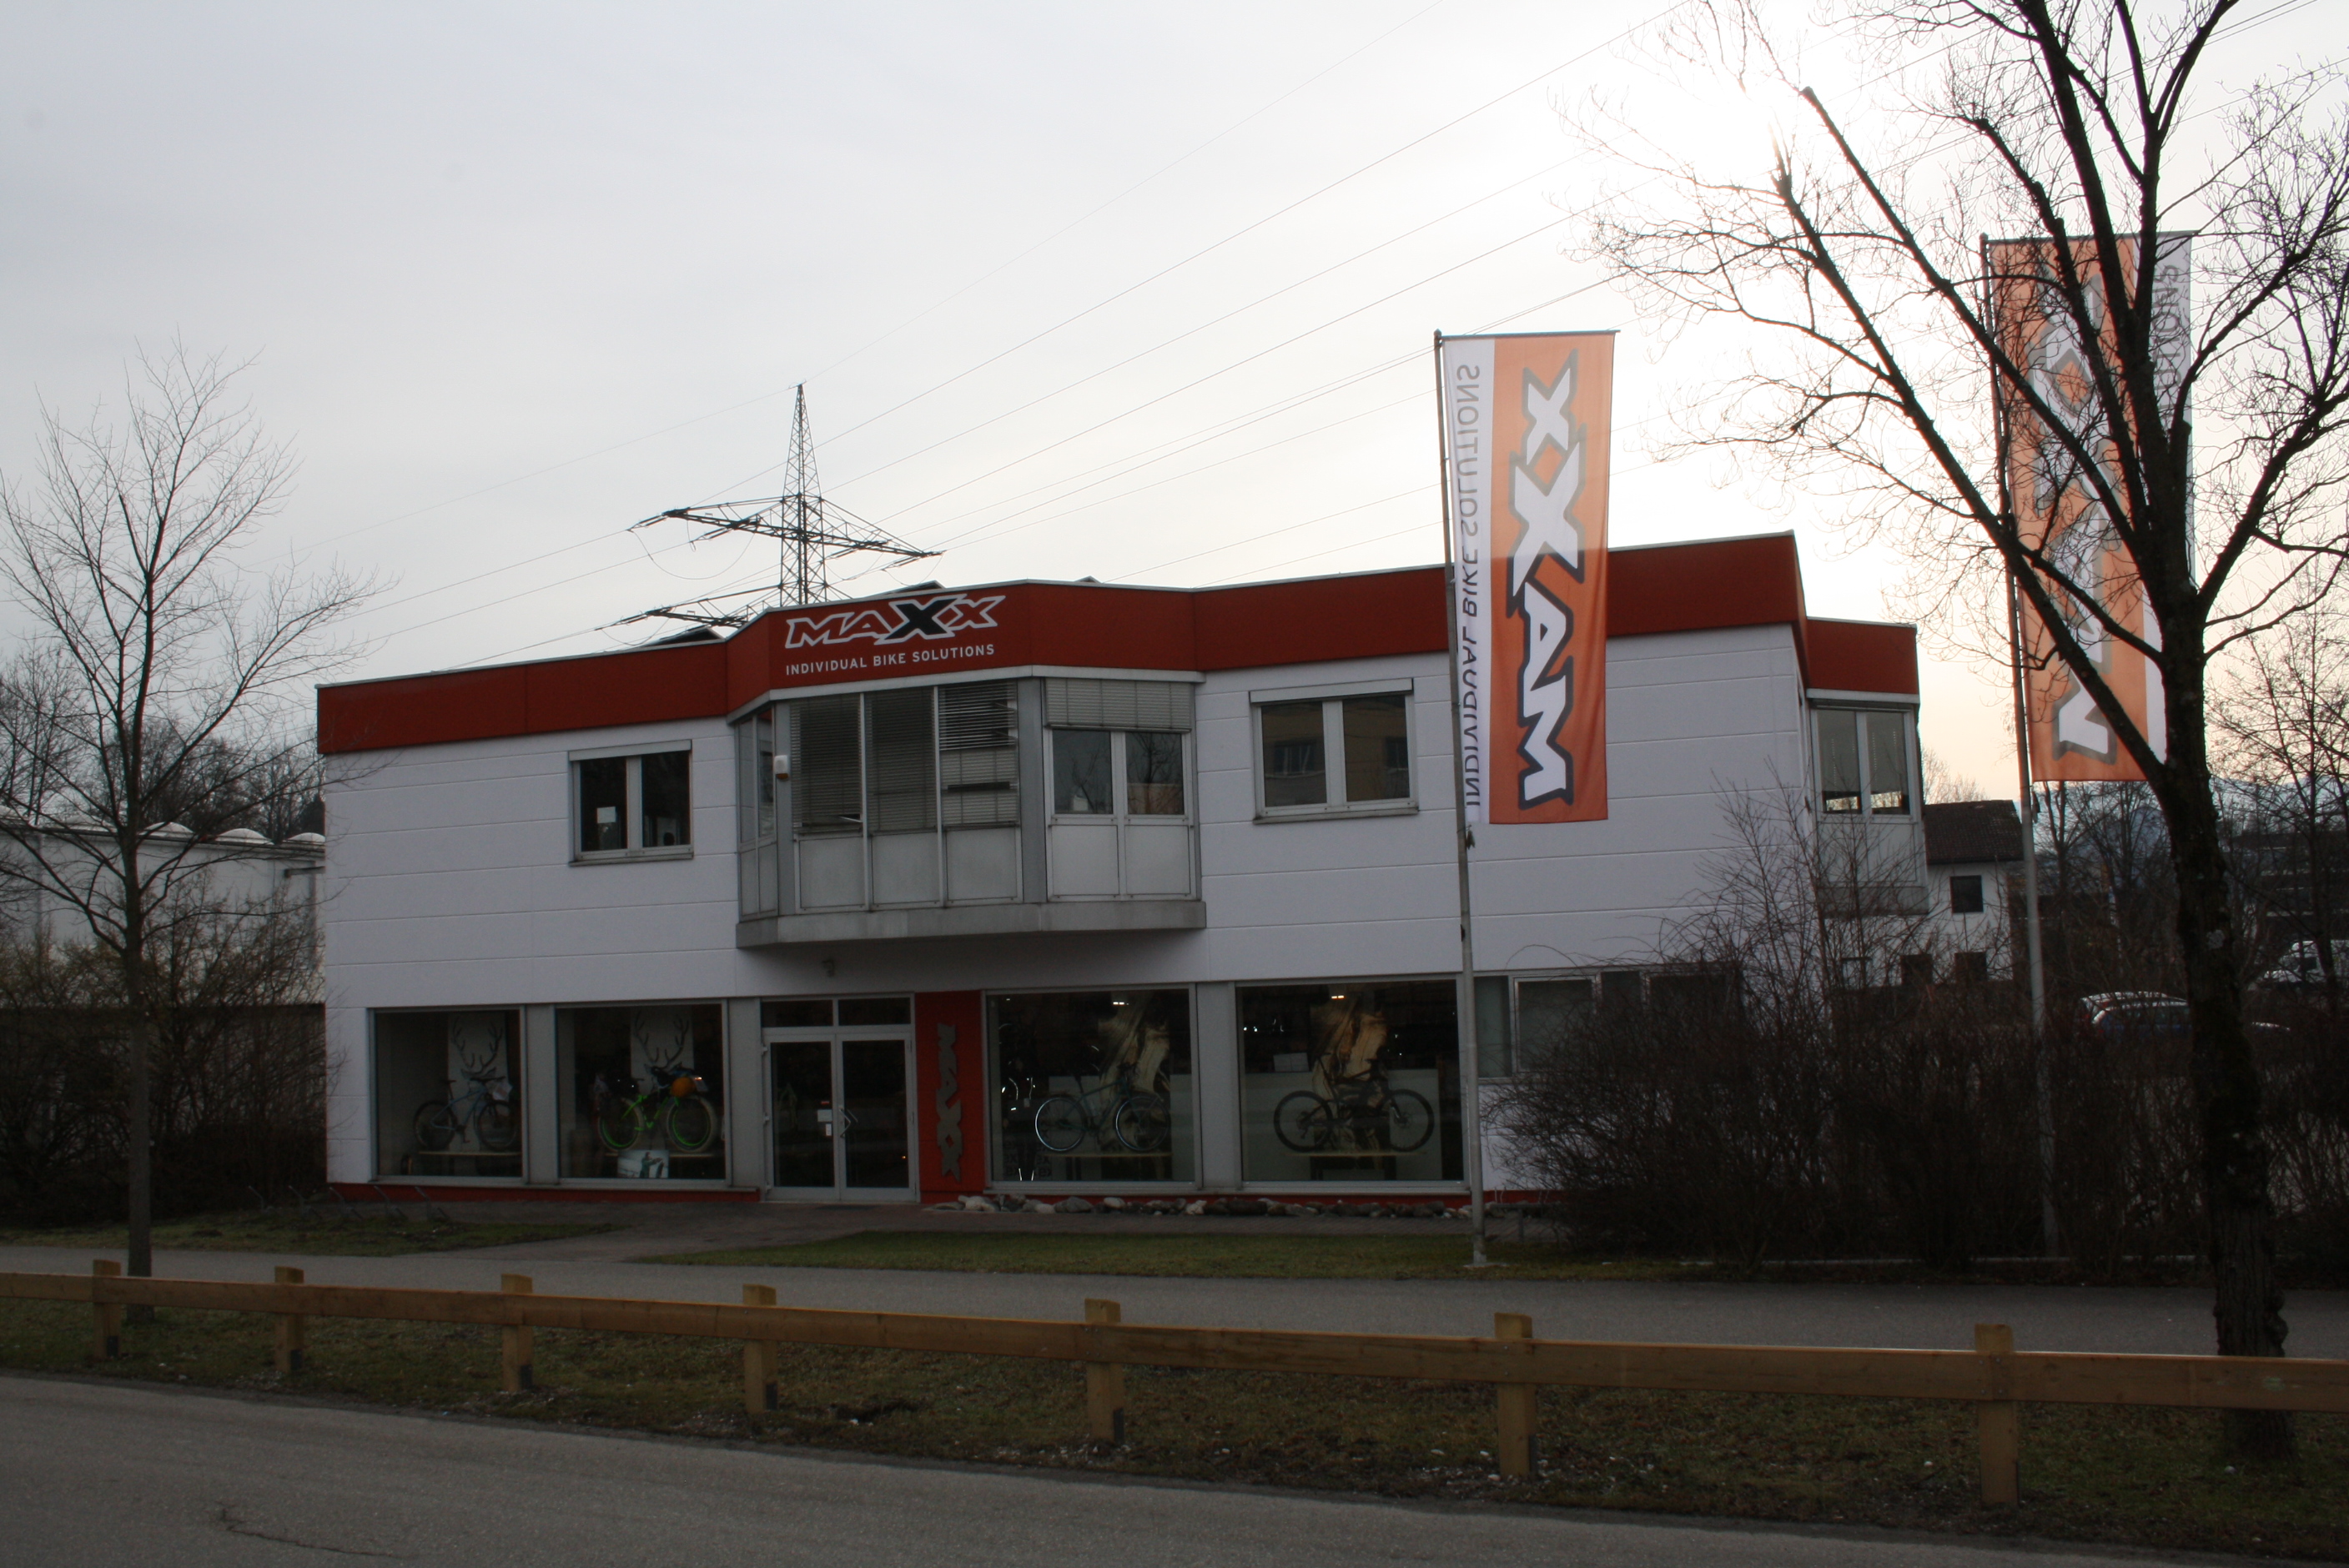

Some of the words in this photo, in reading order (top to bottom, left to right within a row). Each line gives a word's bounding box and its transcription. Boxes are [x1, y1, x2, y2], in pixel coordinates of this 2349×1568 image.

[784, 593, 1006, 649] MAXX
[786, 656, 868, 676] INDIVIDUAL
[873, 652, 907, 667] BIKE
[912, 643, 995, 663] SOLUTIONS
